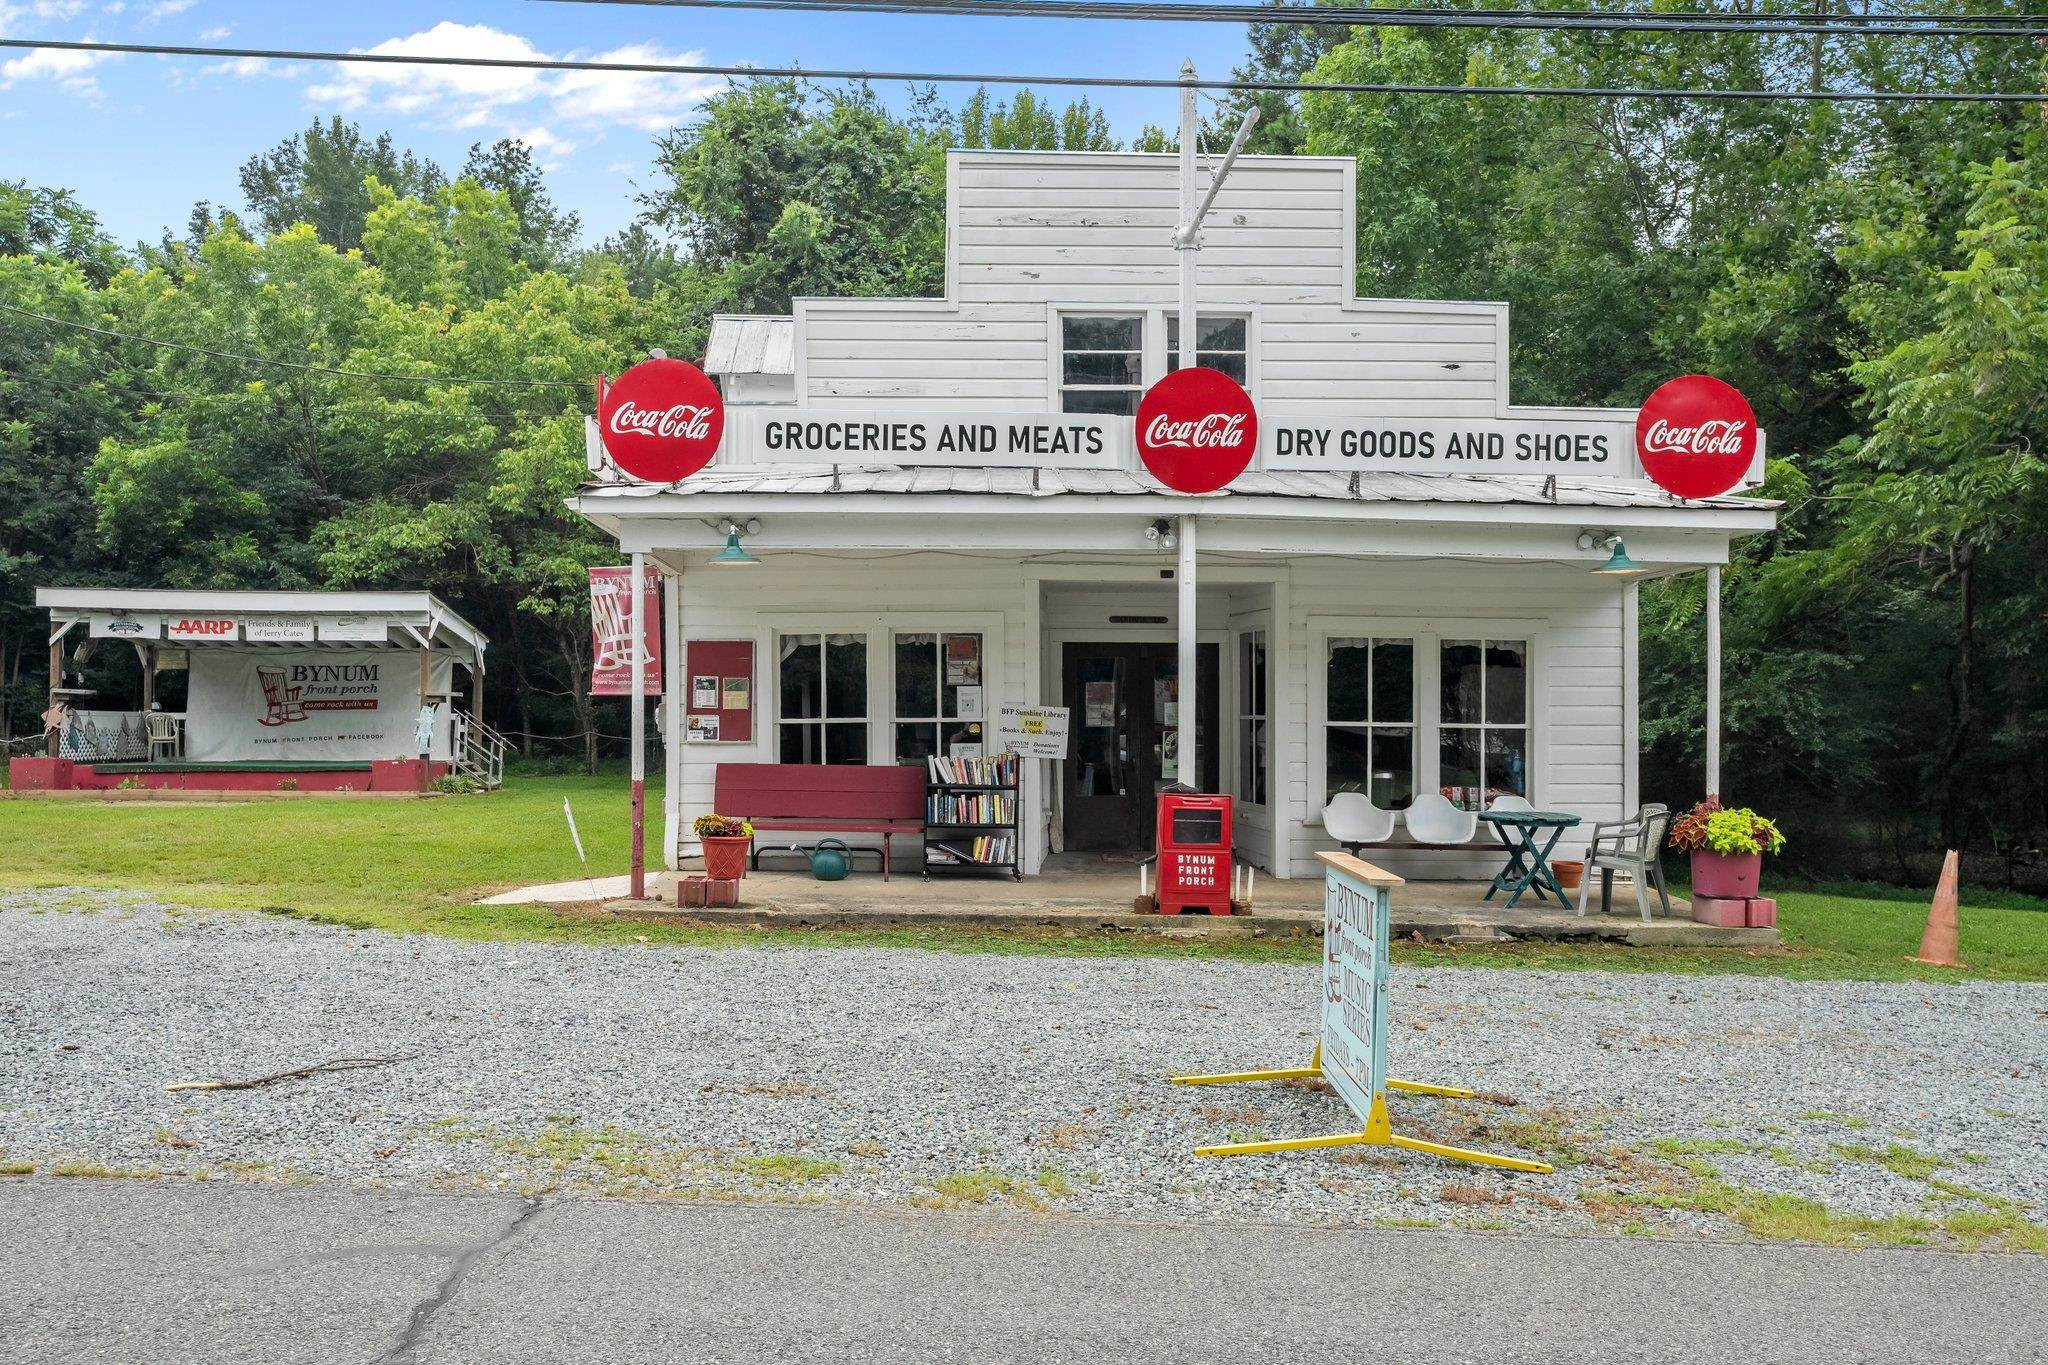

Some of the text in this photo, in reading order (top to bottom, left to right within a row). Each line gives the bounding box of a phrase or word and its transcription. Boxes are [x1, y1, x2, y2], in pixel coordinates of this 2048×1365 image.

[610, 401, 715, 440] Coca-Cola
[765, 421, 1103, 454] GROCERIES AND MEATS
[1145, 413, 1248, 448] Coca-Cola
[1644, 419, 1747, 454] Coca-Cola
[1276, 428, 1609, 463] DRY GOODS AND SHOES
[594, 576, 655, 590] BYNM
[170, 619, 234, 635] AARP
[248, 619, 311, 630] Friends & Family
[254, 629, 304, 638] of Jerry Cates
[291, 664, 380, 682] BYNUM
[302, 684, 378, 696] front porch
[345, 700, 361, 708] with
[1015, 709, 1043, 717] Sunshine
[1043, 711, 1067, 719] Library
[1024, 720, 1043, 728] FREE
[1045, 729, 1065, 738] Enjoy!
[1178, 855, 1215, 864] BYNUM
[1178, 866, 1214, 875] FRONT
[1178, 877, 1214, 886] PORCH
[1337, 882, 1375, 942] BYNUM
[1354, 944, 1372, 970] porch
[1343, 966, 1371, 1014] MUSIC
[1343, 999, 1371, 1048] SERIES
